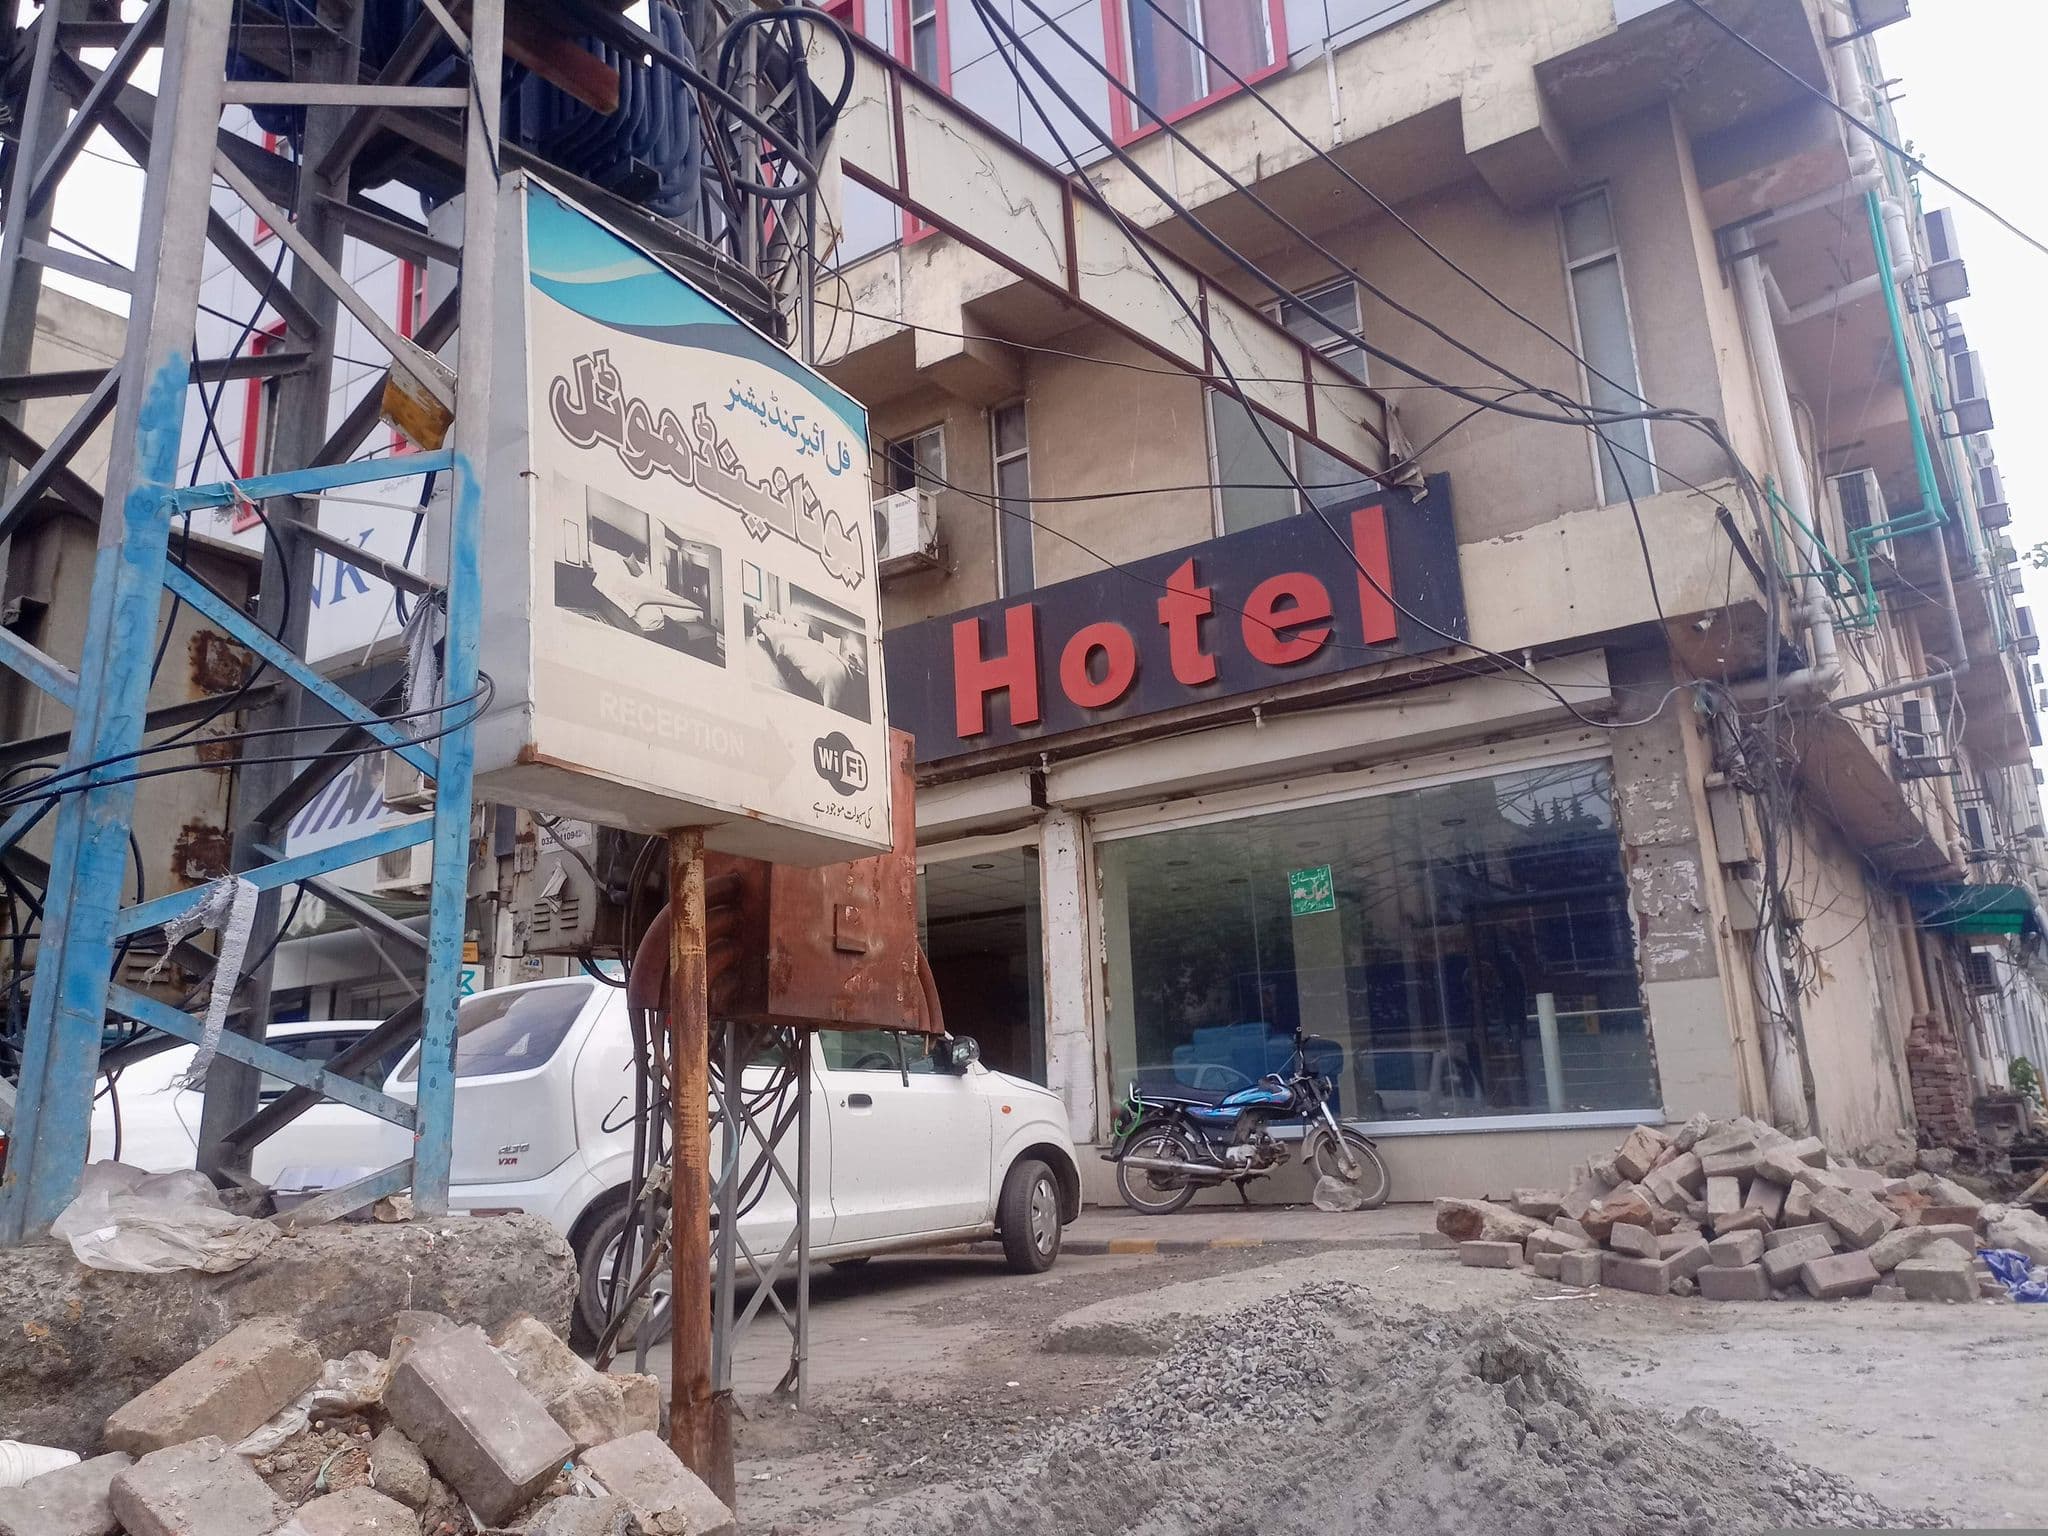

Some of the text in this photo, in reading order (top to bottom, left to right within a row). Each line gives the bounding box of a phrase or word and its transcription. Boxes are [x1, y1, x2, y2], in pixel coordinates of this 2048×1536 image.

[952, 504, 1397, 738] Hotel
[600, 692, 745, 759] RECEPTION
[498, 1157, 518, 1166] VXR
